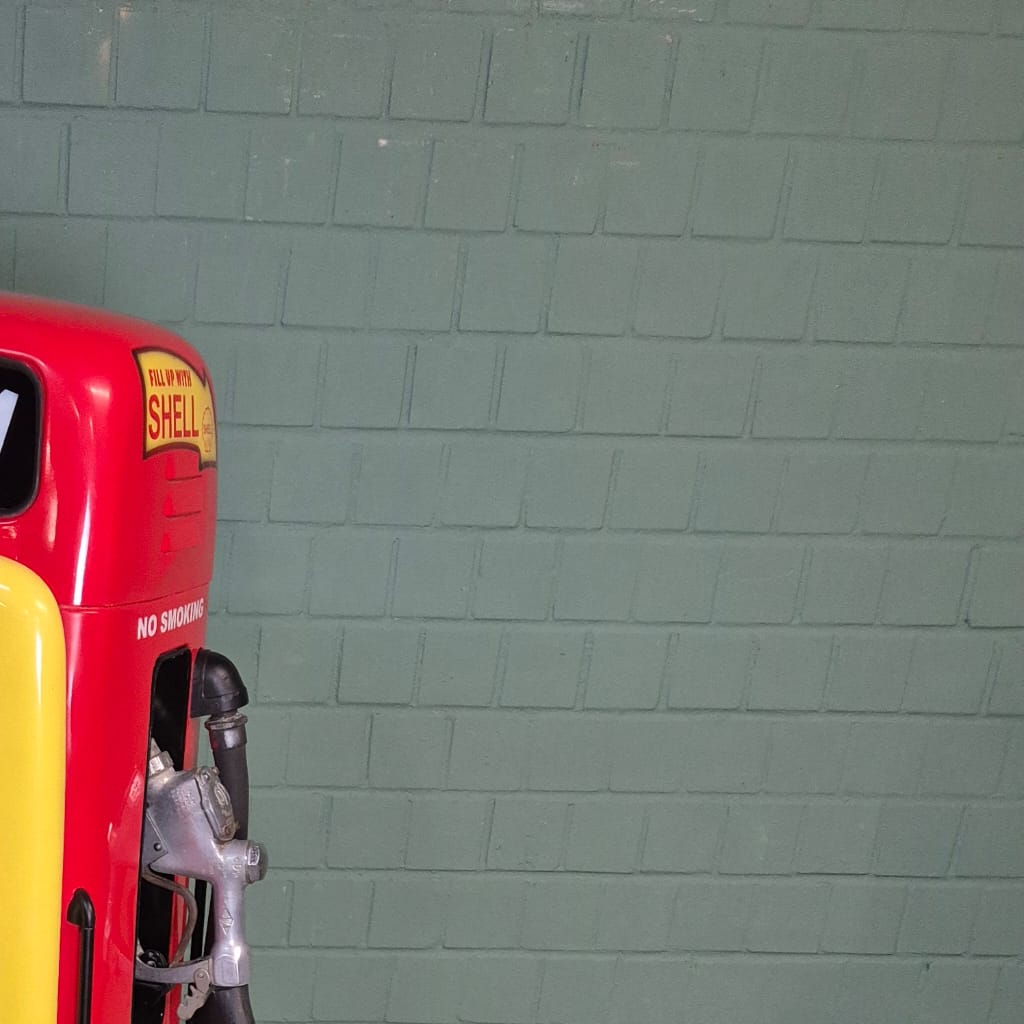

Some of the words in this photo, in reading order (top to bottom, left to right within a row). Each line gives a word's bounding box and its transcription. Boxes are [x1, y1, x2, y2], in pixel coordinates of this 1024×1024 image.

[148, 369, 165, 387] FILL
[165, 369, 175, 387] UP
[175, 369, 192, 387] WITH
[148, 394, 199, 440] SHELL
[137, 614, 157, 641] NO
[160, 598, 204, 633] SMOKING
